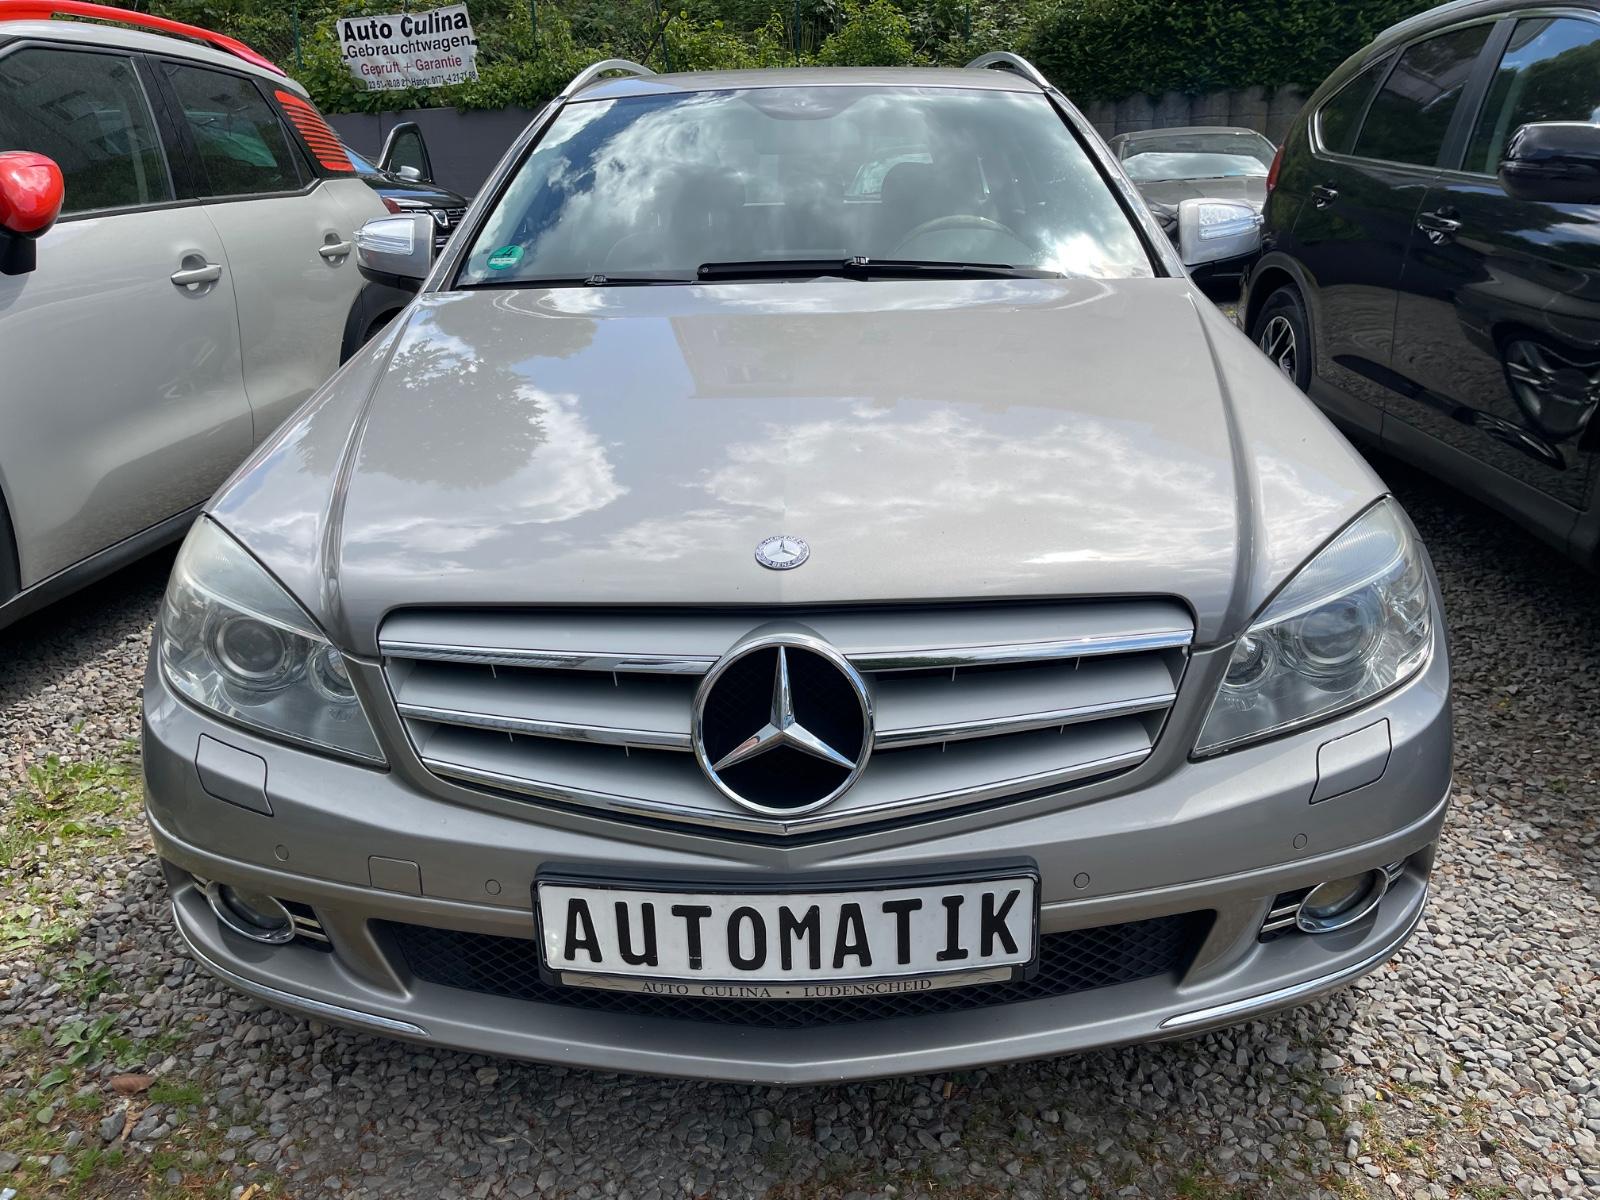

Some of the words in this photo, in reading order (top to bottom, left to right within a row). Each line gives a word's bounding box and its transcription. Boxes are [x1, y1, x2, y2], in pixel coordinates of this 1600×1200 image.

[344, 20, 392, 42] Auto
[400, 12, 468, 37] Culina
[347, 35, 470, 58] Gebrauchtwagen
[361, 61, 400, 77] Geprüft
[415, 55, 462, 71] Garantie
[502, 246, 515, 257] 4
[564, 889, 1021, 971] AUTOMATIK
[642, 981, 689, 995] AUTO
[702, 984, 771, 998] CULINA
[804, 979, 932, 997] LÜDENSCHEID
